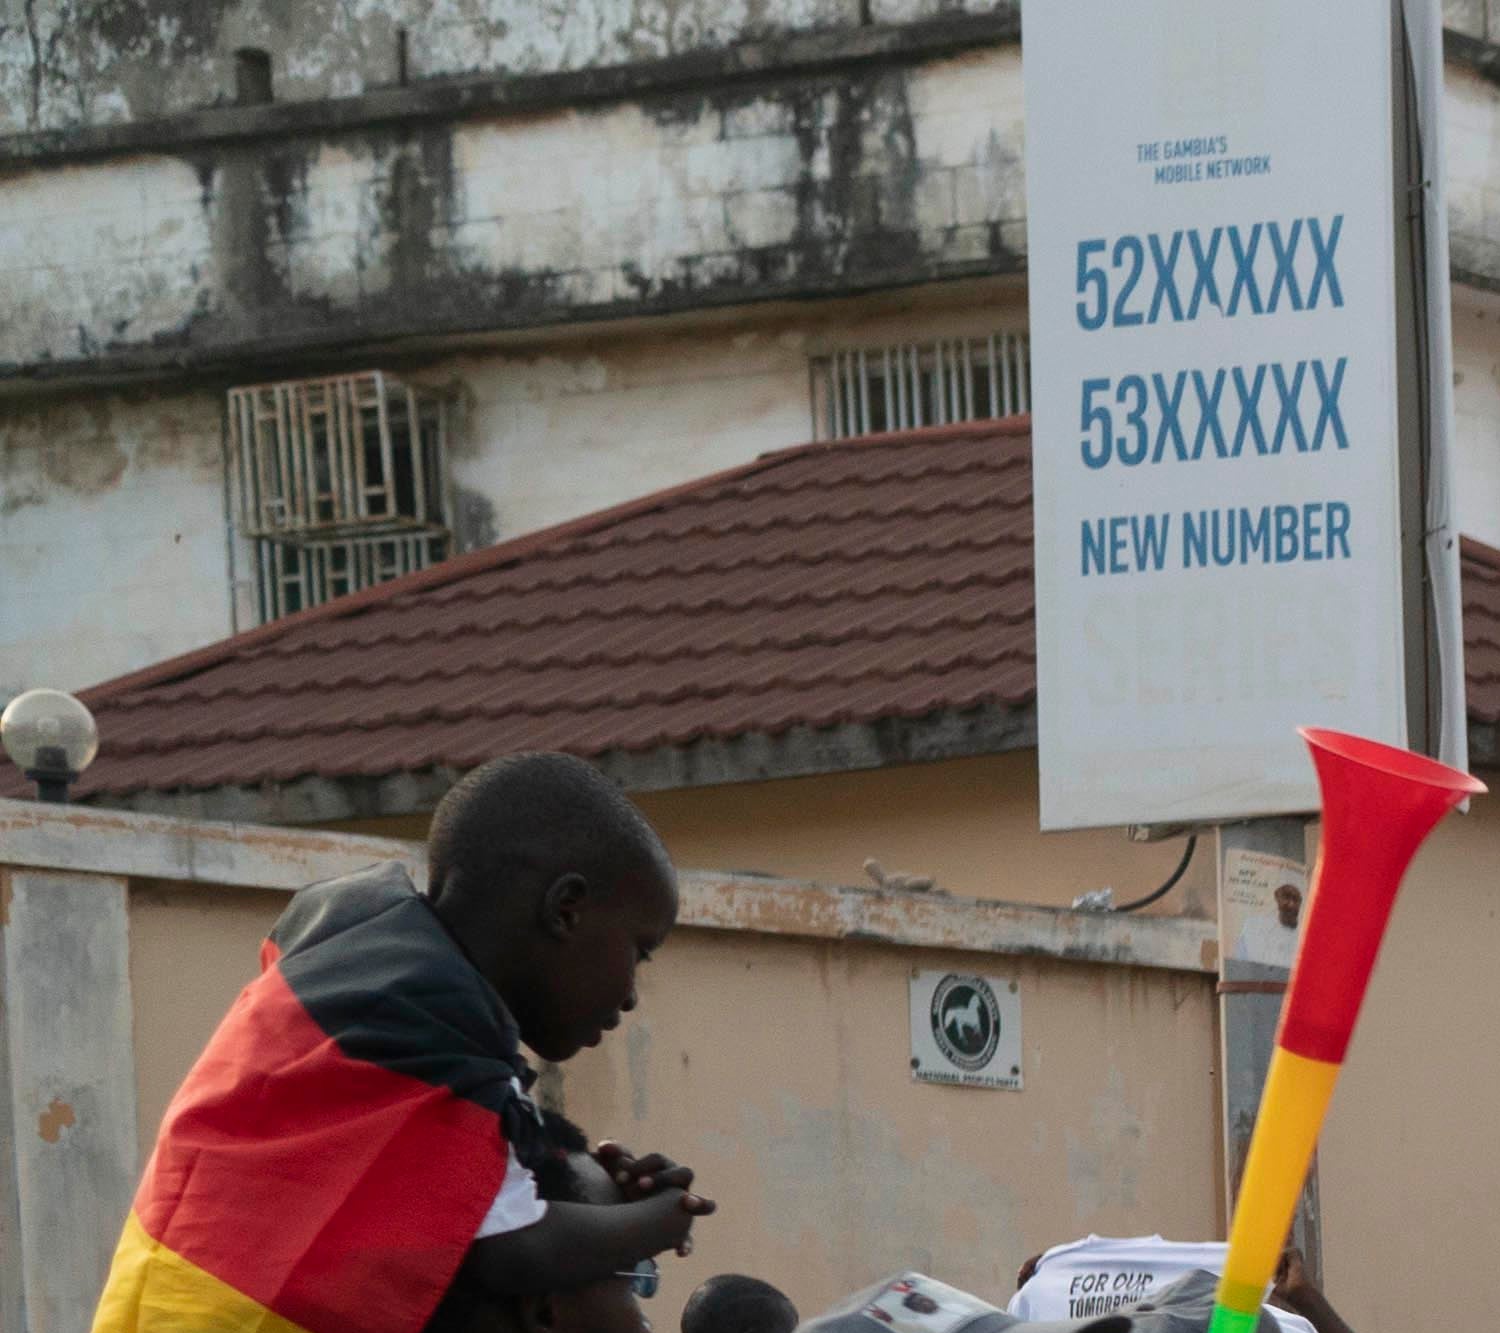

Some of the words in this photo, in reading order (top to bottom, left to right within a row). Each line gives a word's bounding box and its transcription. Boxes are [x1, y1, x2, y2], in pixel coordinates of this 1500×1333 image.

[1137, 142, 1159, 163] THE
[1164, 136, 1228, 160] GAMBIA'S
[1154, 162, 1202, 184] MOBILE
[1207, 155, 1271, 179] NETWORK
[1076, 214, 1345, 331] 52XXXXX
[1080, 356, 1349, 470] 53XXXXX
[1081, 513, 1170, 577] NEW
[1182, 502, 1351, 569] NUMBER
[1069, 1273, 1109, 1296] FOR
[1112, 1271, 1154, 1292] OUR
